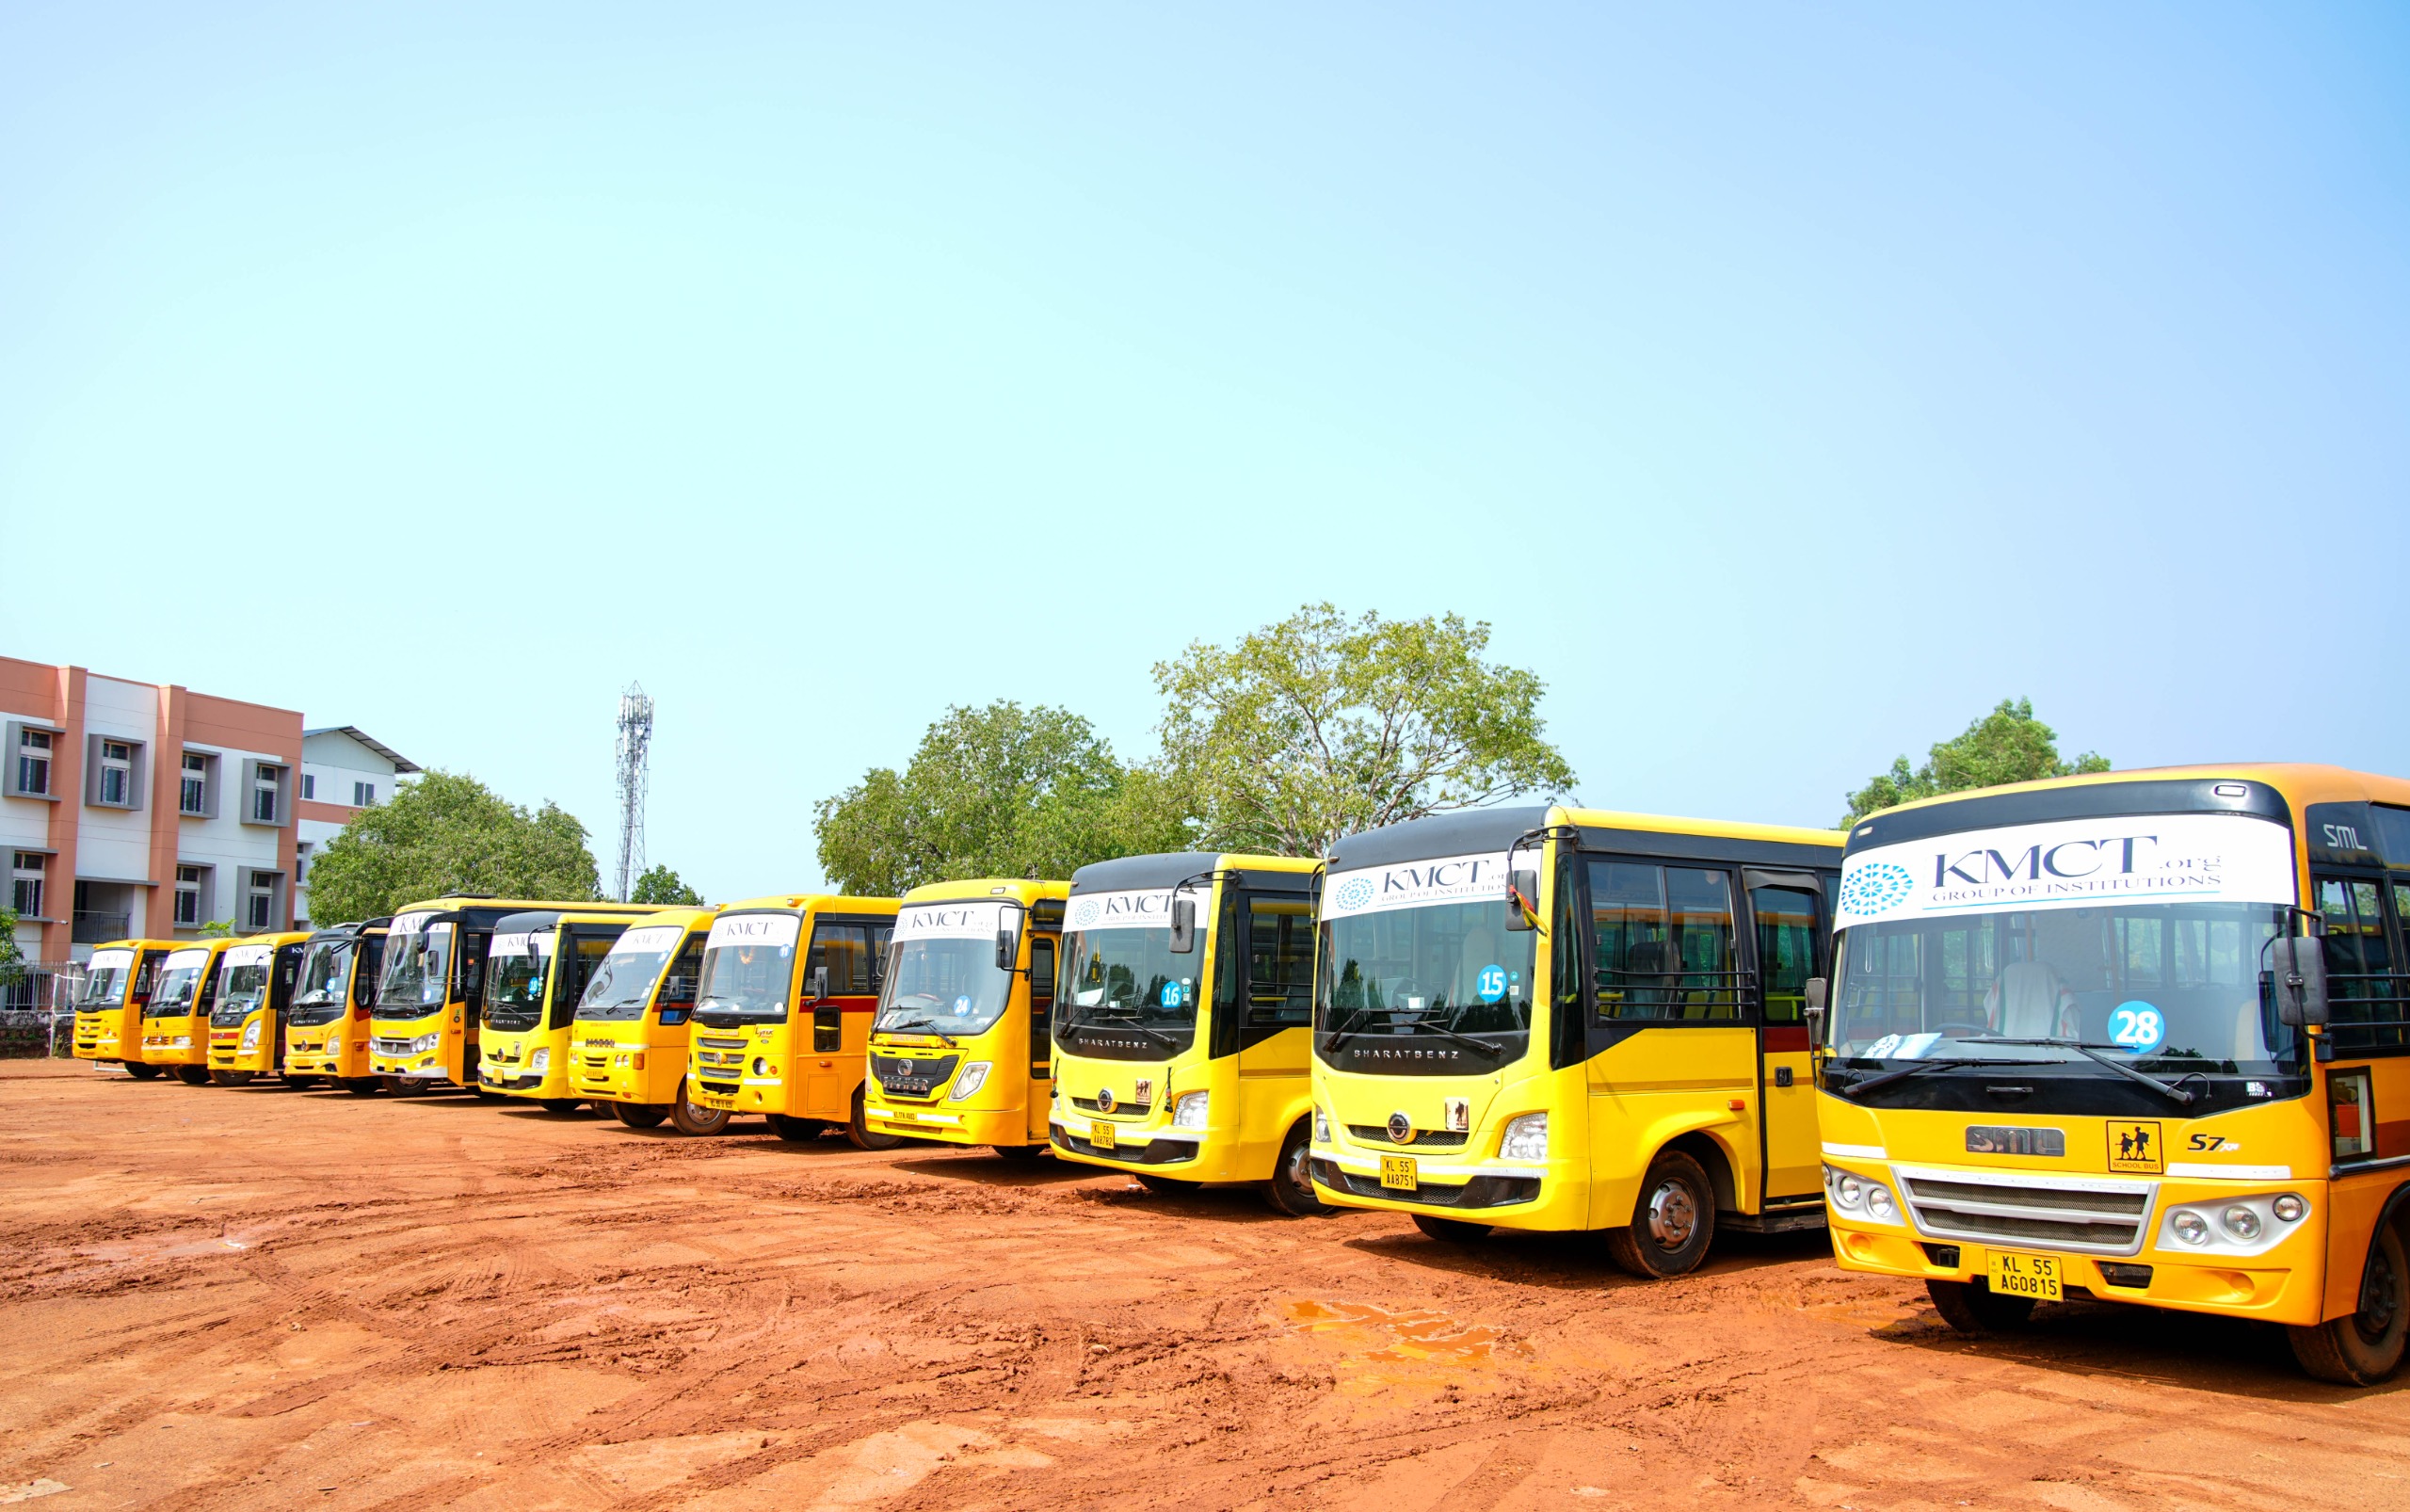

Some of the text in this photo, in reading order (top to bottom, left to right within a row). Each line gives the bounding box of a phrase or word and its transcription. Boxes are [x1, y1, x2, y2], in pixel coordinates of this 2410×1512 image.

[2322, 823, 2368, 850] SML
[1933, 835, 2158, 888] KMCT
[1383, 860, 1489, 893] KMCT
[1381, 891, 1415, 902] GROUP
[1933, 875, 2221, 902] GROUP OF INSTITUTIONS
[1105, 894, 1172, 914] KMCT
[912, 910, 974, 928] KMCT
[727, 922, 773, 936] KMCT
[1481, 972, 1503, 995] 15
[1164, 987, 1179, 1005] 16
[955, 999, 969, 1013] 24
[2115, 1010, 2159, 1045] 28
[1078, 1037, 1147, 1049] BHARATBENZ
[1354, 1050, 1458, 1059] BHARATBENZ
[1094, 1124, 1110, 1134] KL 55
[2187, 1134, 2225, 1151] S7
[1386, 1160, 1409, 1173] KL 55
[1386, 1173, 1414, 1187] AA8751
[2002, 1255, 2052, 1276] KL 55
[2001, 1274, 2057, 1295] AG0815
